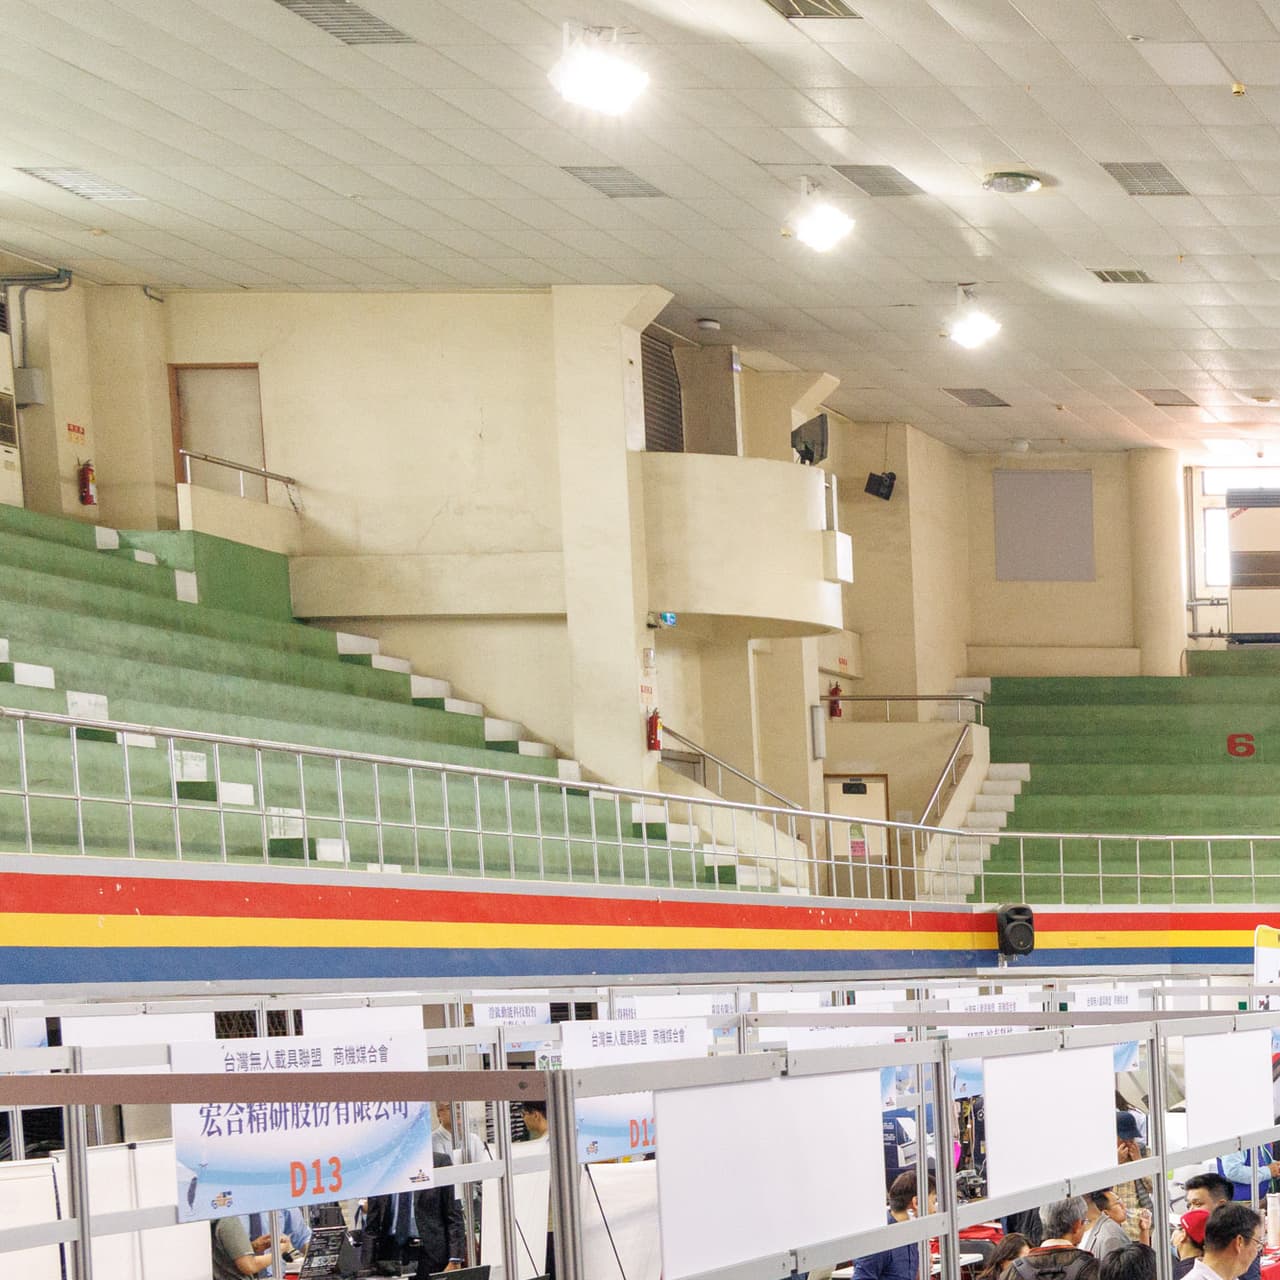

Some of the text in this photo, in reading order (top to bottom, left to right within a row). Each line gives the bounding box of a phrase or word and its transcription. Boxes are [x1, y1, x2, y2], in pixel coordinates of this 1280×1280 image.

[1227, 733, 1255, 757] 6
[223, 1045, 389, 1073] 台灣無人載具聯盟 商機媒合會
[289, 1156, 343, 1198] D13
